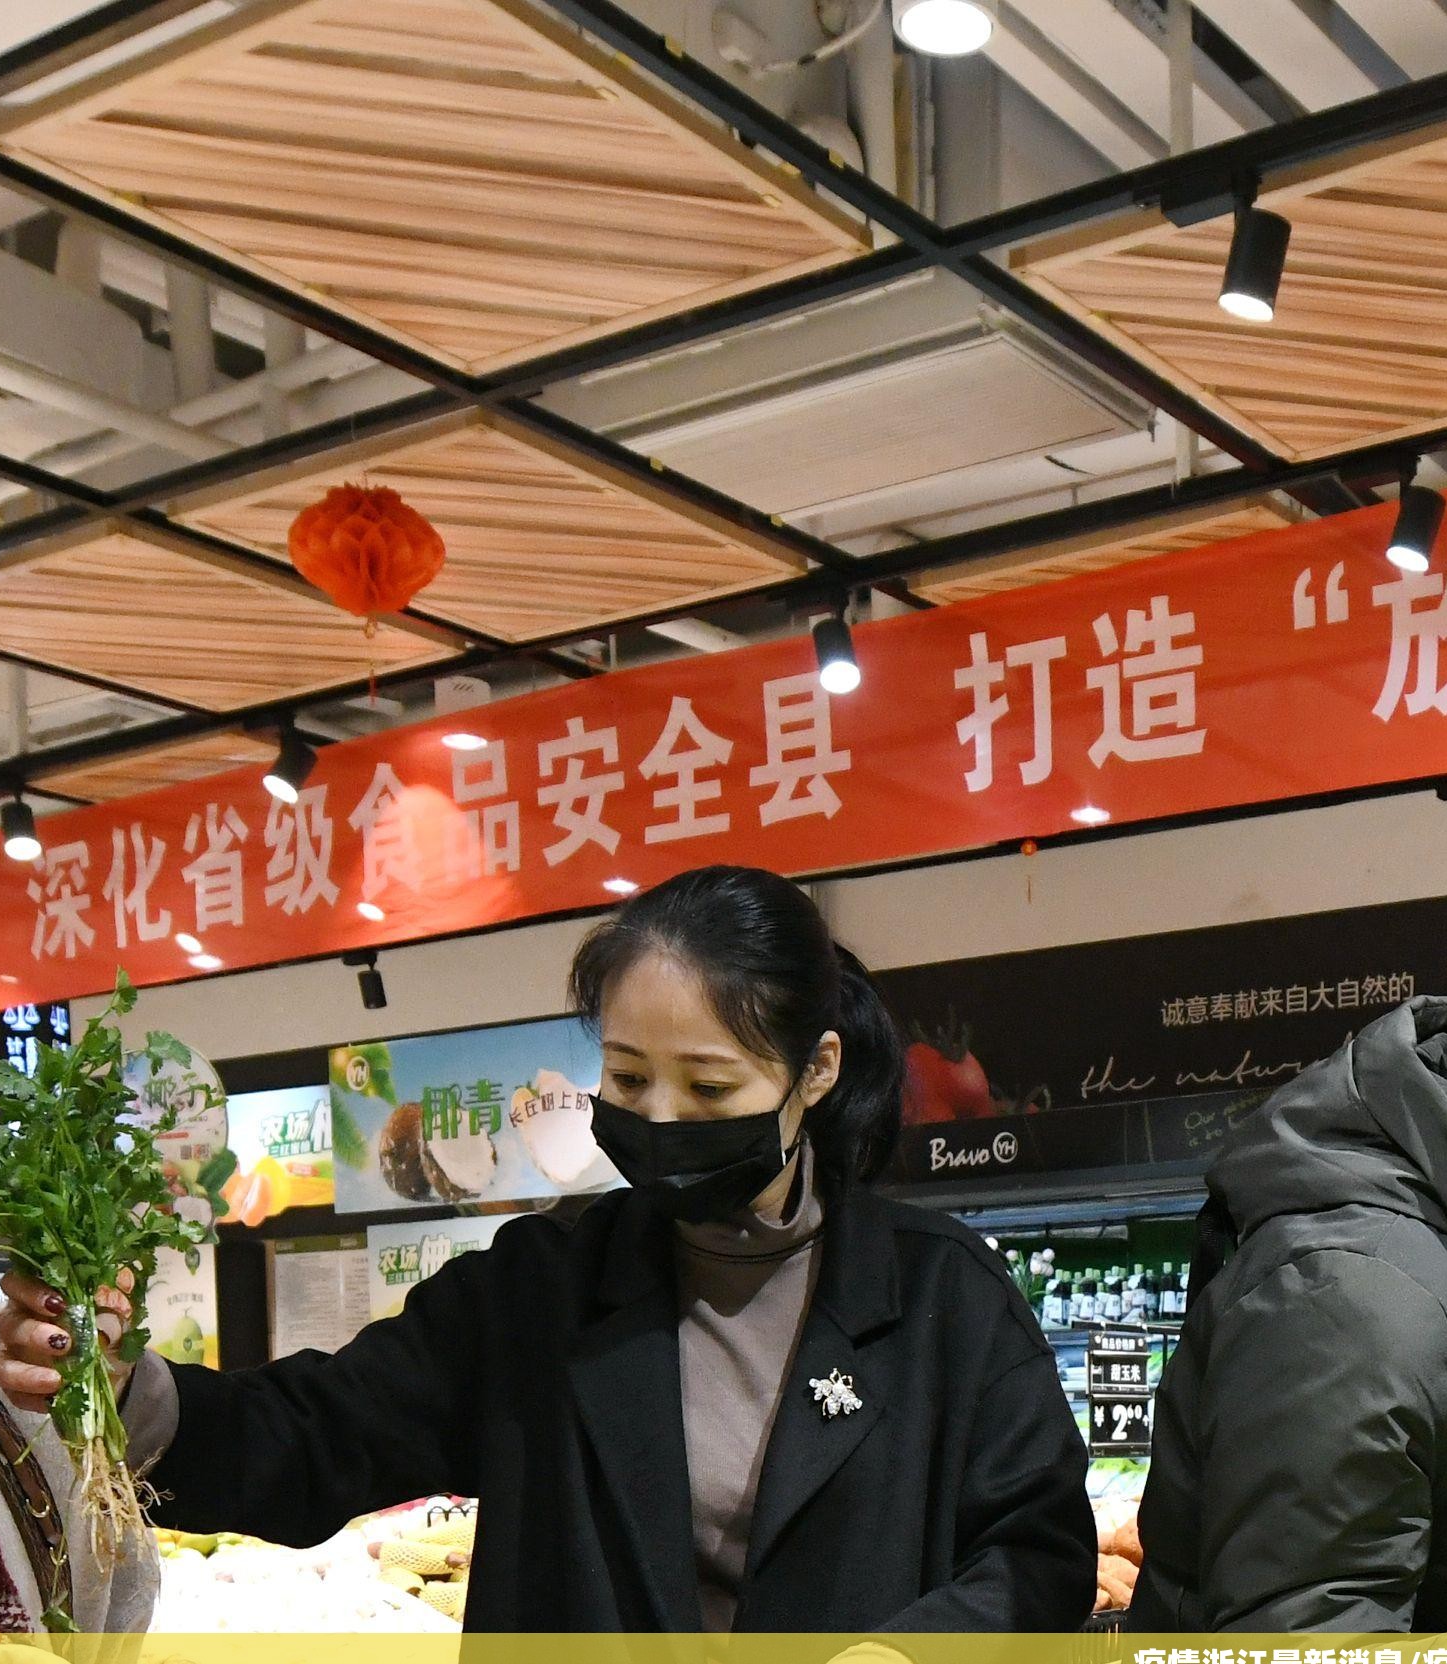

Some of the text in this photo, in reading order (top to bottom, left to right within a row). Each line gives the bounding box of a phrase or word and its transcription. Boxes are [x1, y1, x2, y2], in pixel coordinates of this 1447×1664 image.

[26, 667, 853, 962] 深化省级食品安全县
[953, 594, 1209, 794] 打造
[1160, 971, 1416, 1028] 诚意奉献来自大自然的
[1081, 1050, 1303, 1099] the natur
[421, 1078, 506, 1142] 椰青
[928, 1136, 991, 1171] Bravo
[1110, 1363, 1142, 1382] 甜玉米
